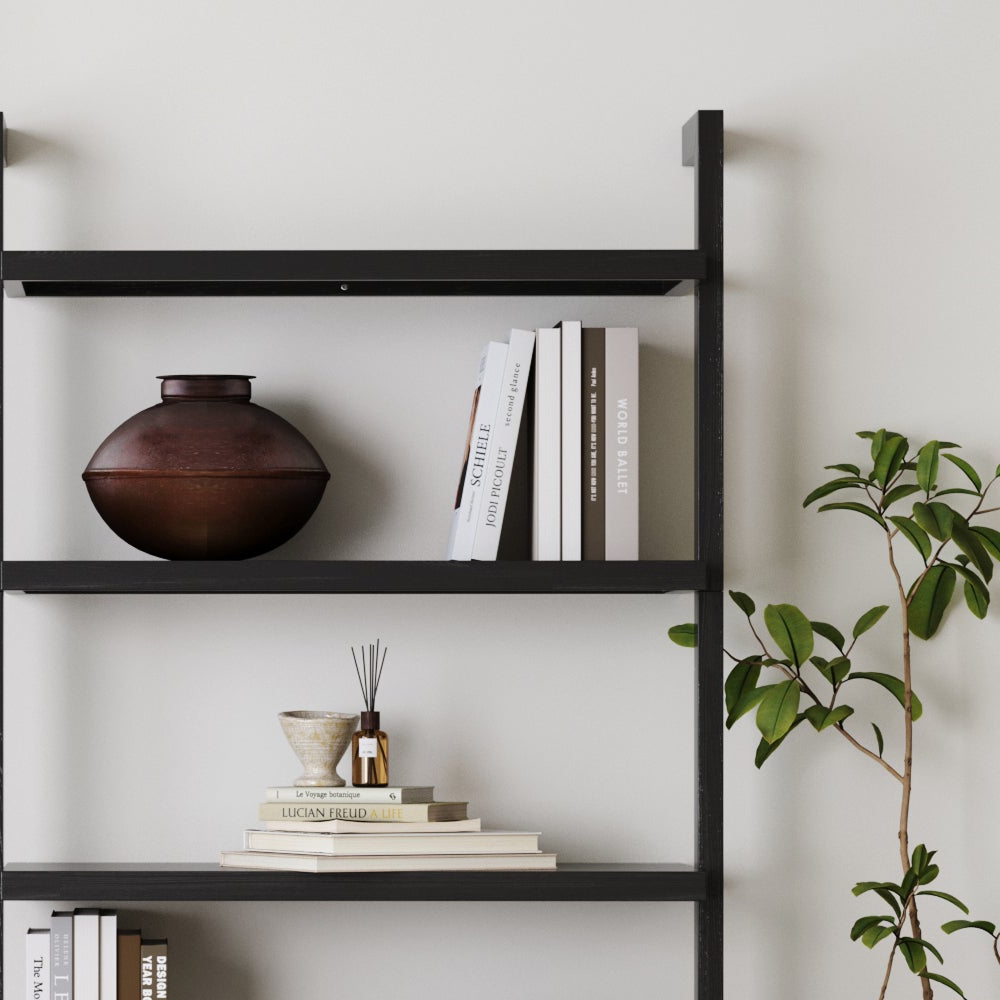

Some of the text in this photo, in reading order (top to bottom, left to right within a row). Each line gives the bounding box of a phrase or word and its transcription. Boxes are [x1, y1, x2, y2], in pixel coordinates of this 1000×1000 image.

[505, 362, 520, 427] second glance
[471, 423, 491, 486] SCHIELE
[616, 398, 628, 495] WORLD BALLET
[486, 446, 509, 528] JODI PICOULT
[282, 807, 403, 819] LUCIAN FREUD A LIFE
[296, 790, 360, 799] Le Voyage botanique
[33, 957, 44, 978] The
[142, 956, 153, 986] YEAR
[156, 956, 167, 999] DESIGN
